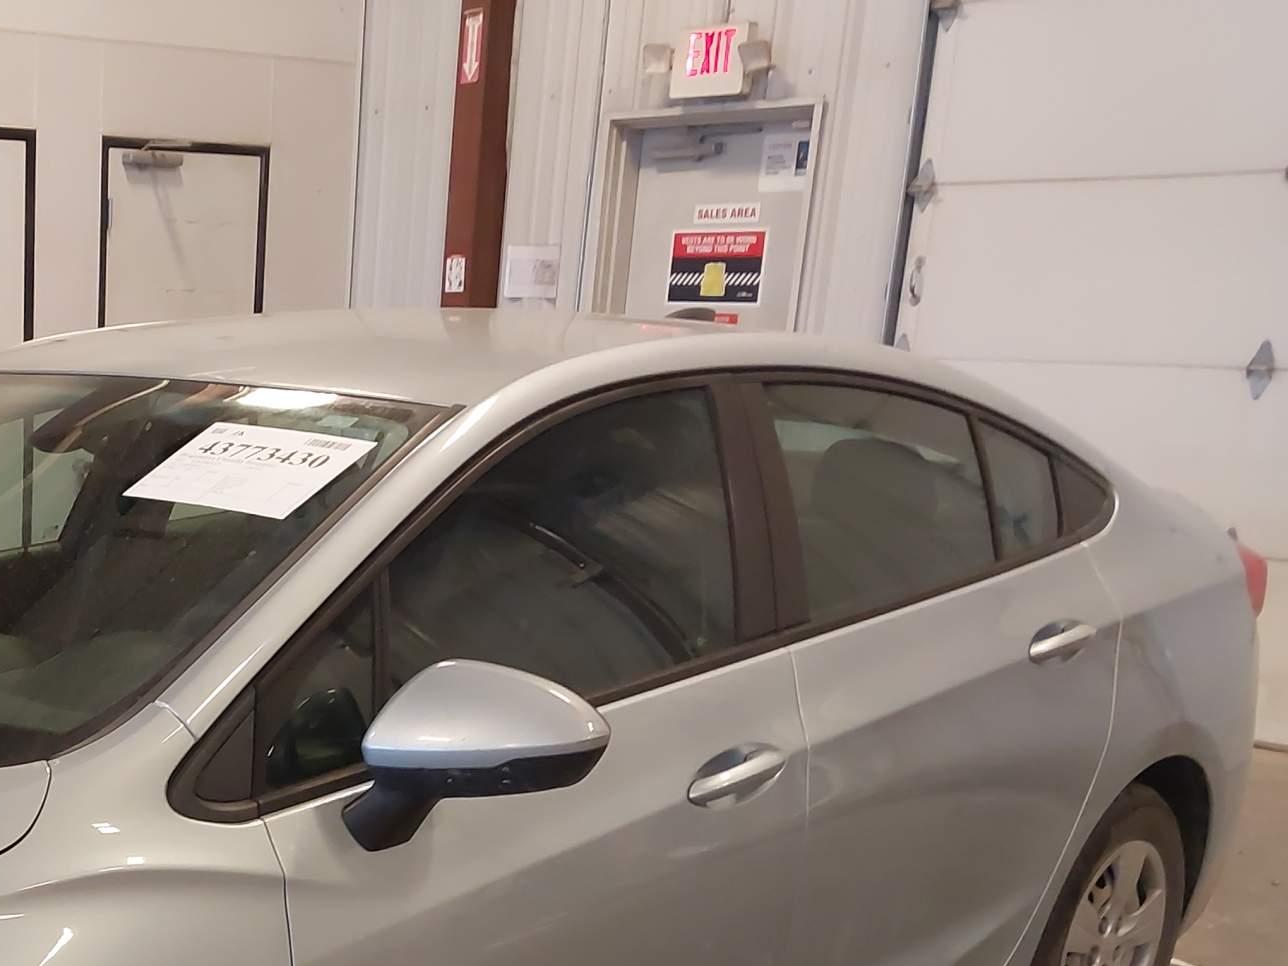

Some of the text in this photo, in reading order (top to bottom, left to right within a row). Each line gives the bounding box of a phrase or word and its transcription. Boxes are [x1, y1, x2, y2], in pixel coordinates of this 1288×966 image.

[686, 29, 736, 77] EXIT
[697, 207, 756, 219] SALES AREA
[198, 440, 330, 469] 43773430
